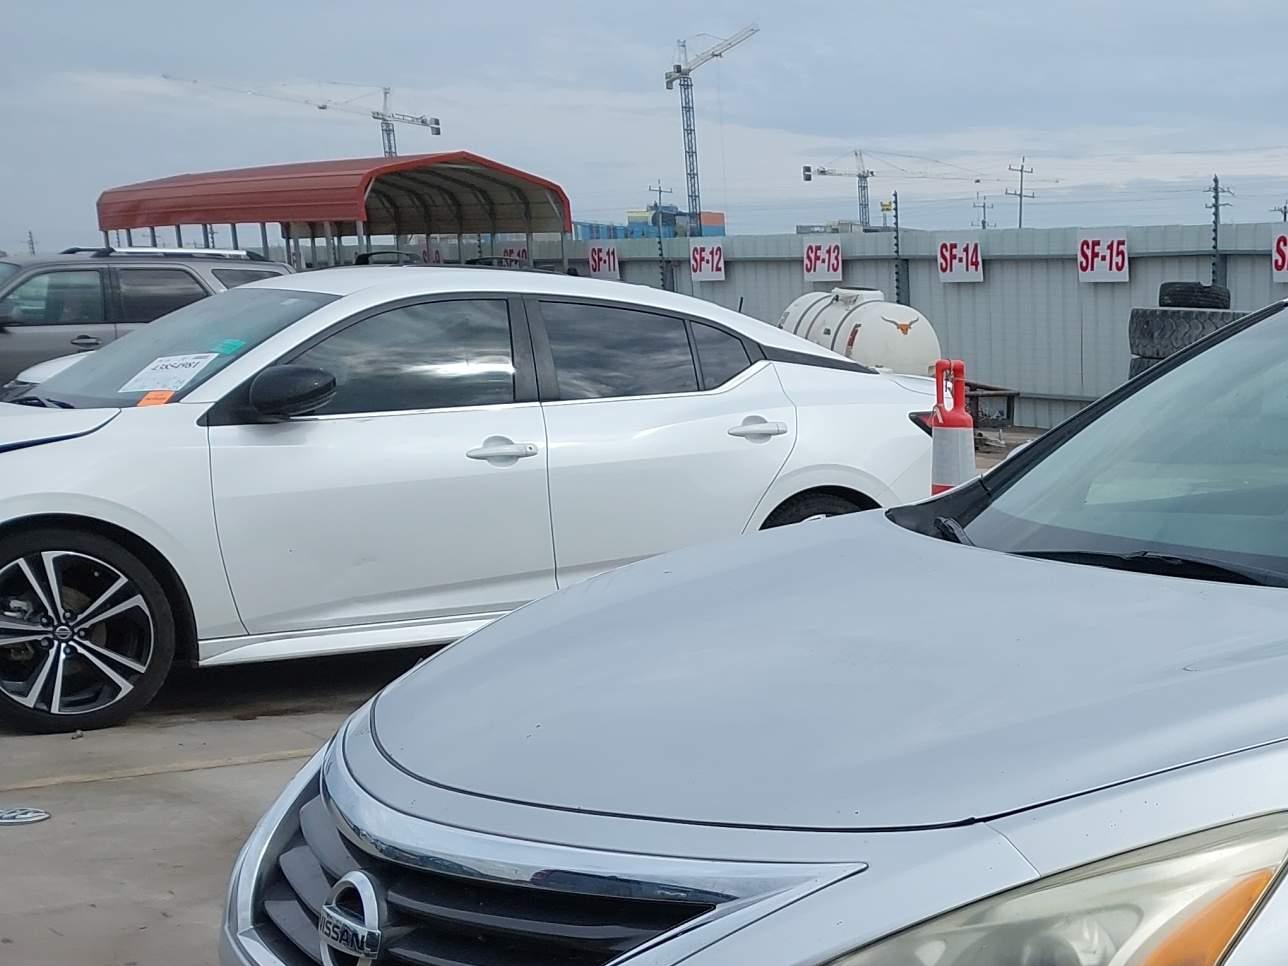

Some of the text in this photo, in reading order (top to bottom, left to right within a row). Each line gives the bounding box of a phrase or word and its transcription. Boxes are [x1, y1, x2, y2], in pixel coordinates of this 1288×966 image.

[591, 247, 616, 273] SF-11
[691, 246, 723, 273] SF-12
[805, 244, 840, 273] SF-13
[939, 242, 980, 273] SF-14
[1079, 239, 1126, 272] SF-15
